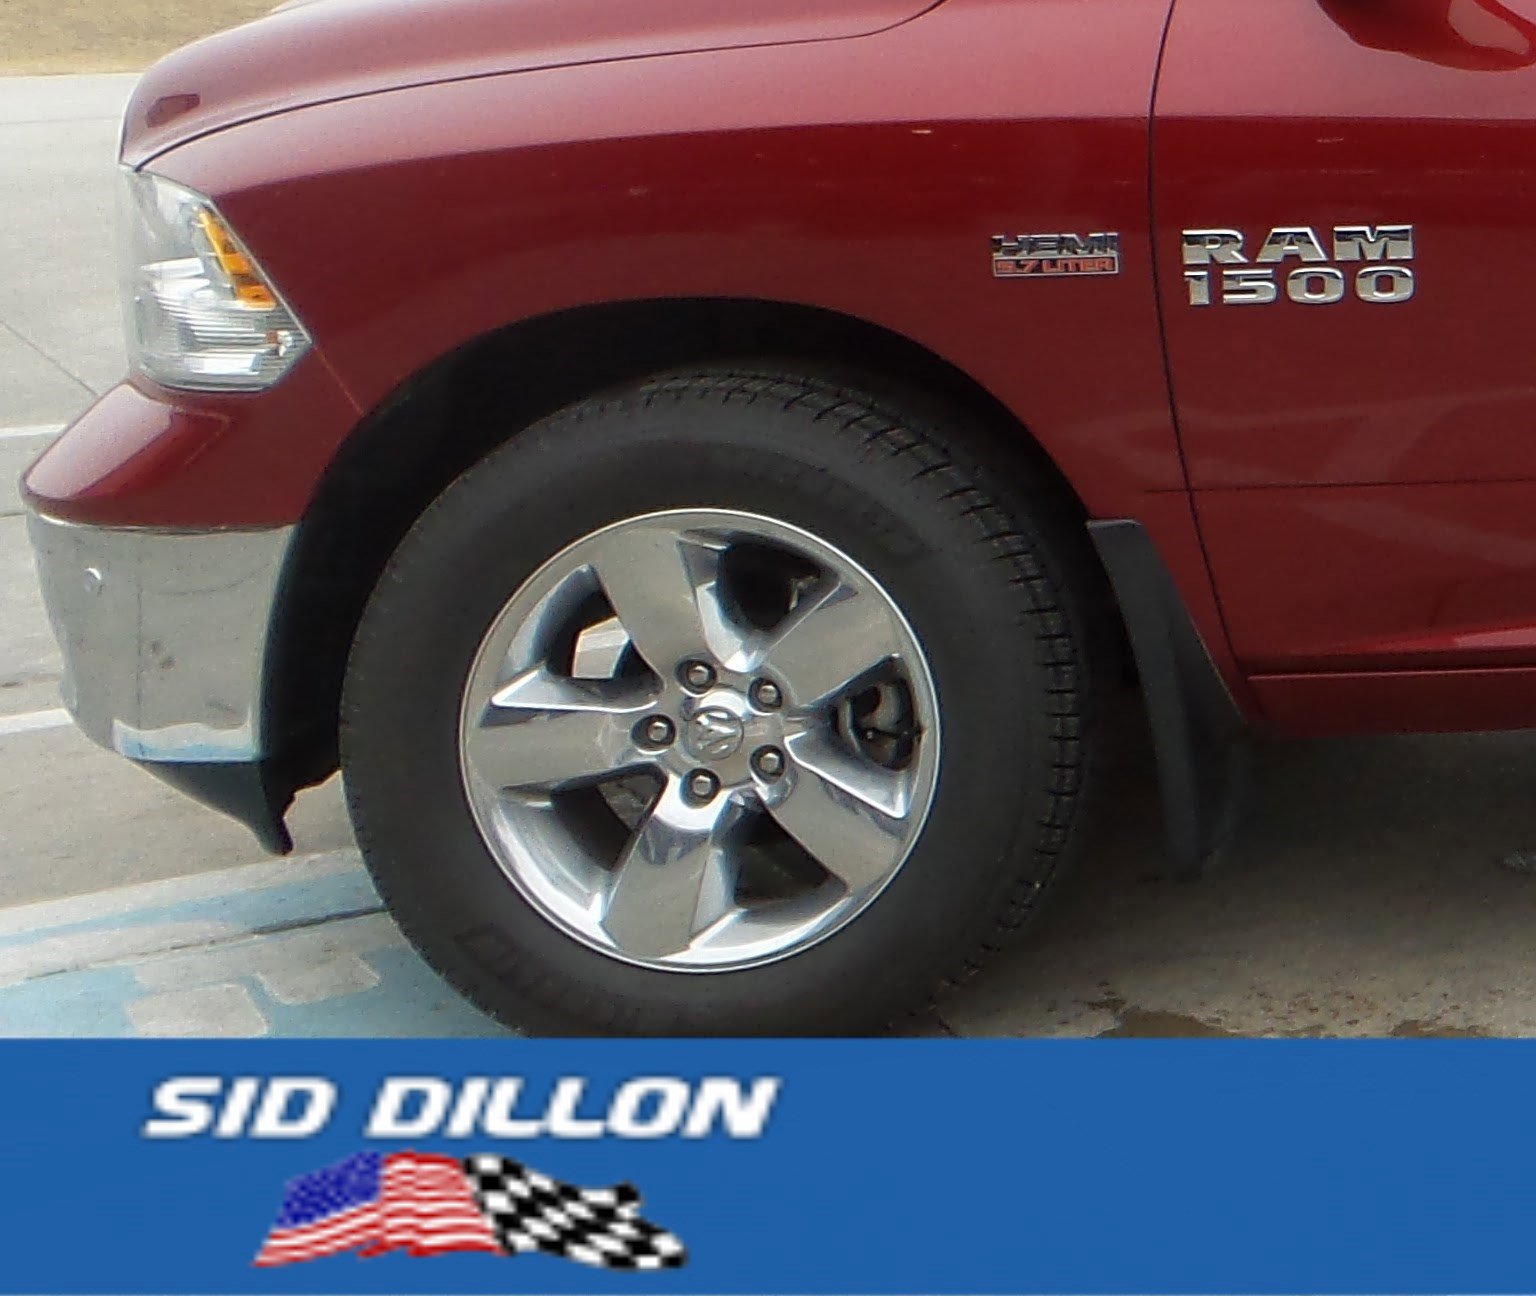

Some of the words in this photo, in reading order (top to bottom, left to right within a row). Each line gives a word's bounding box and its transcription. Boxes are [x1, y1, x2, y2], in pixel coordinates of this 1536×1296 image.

[992, 232, 1118, 257] HEMI
[1181, 224, 1414, 265] RAM
[1041, 257, 1115, 274] LITER
[1184, 266, 1414, 306] 1500
